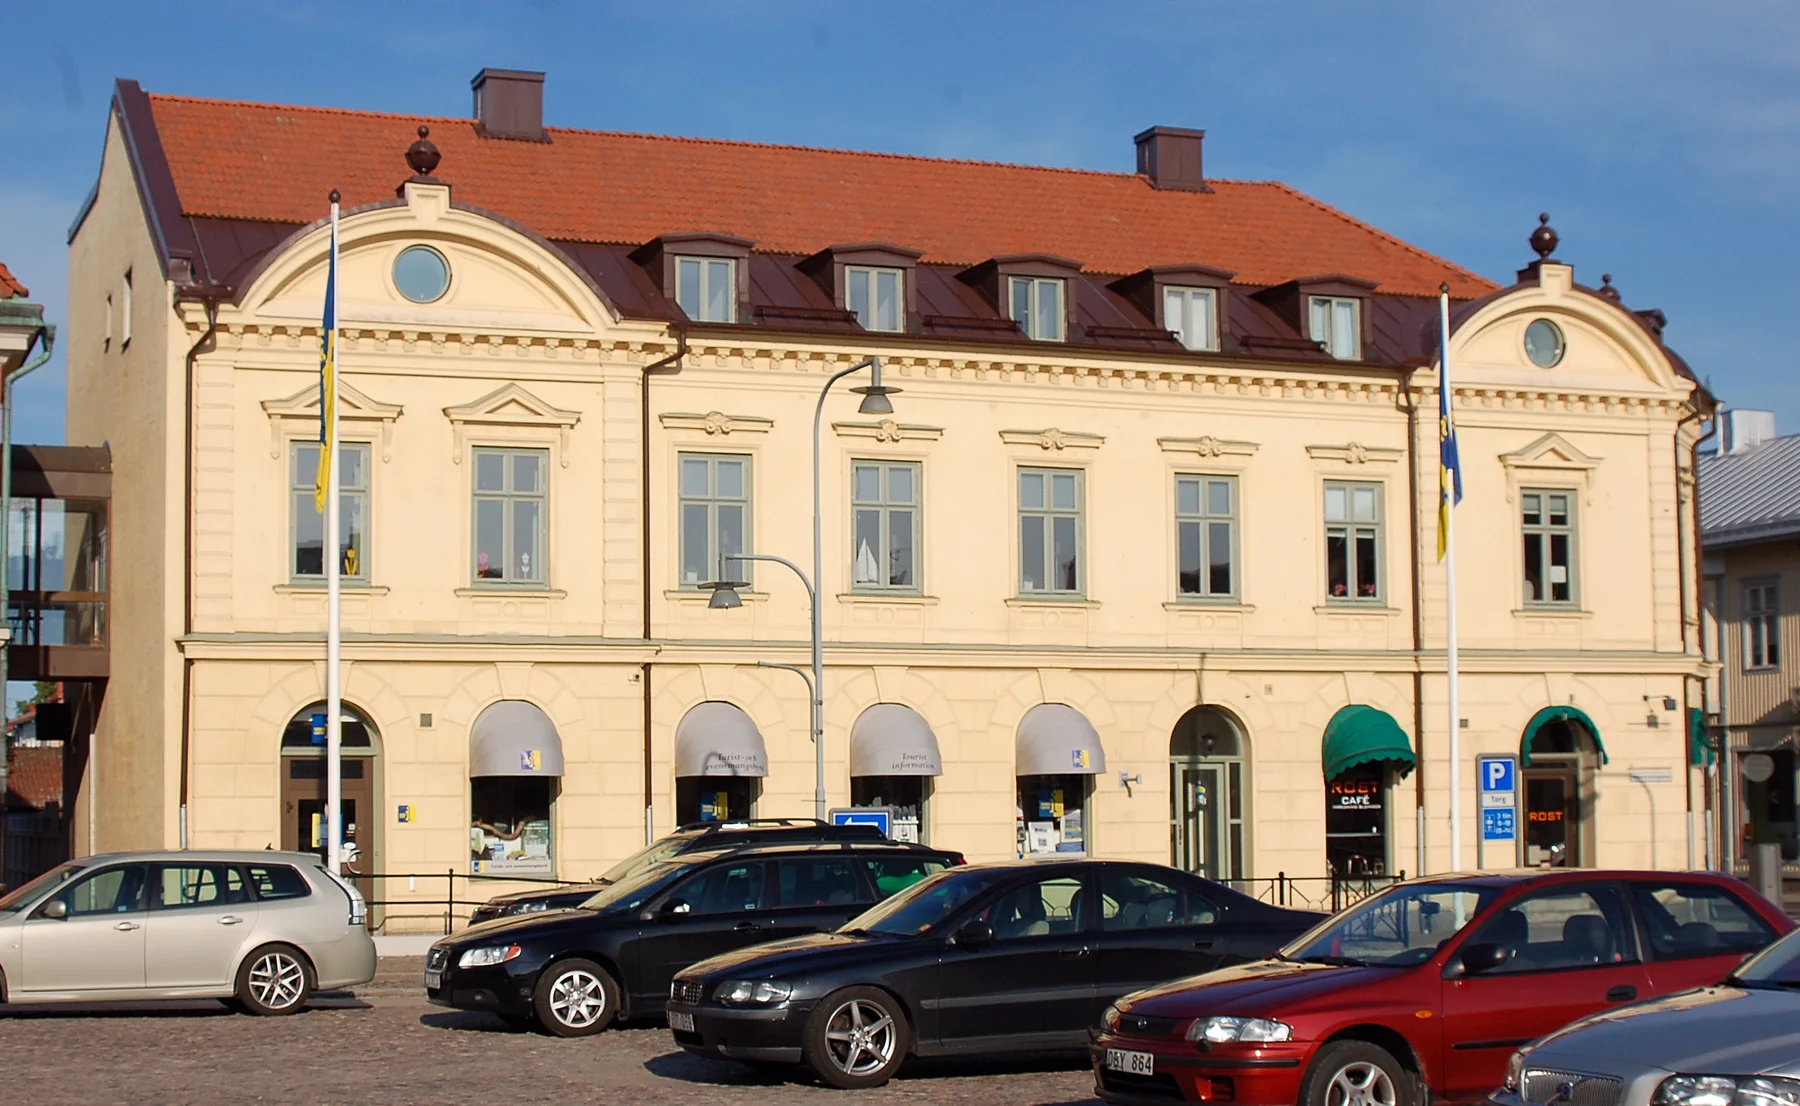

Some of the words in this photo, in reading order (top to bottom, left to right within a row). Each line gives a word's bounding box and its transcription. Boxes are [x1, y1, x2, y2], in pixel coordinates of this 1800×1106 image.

[892, 761, 935, 771] information
[1489, 763, 1506, 789] P
[1332, 781, 1379, 794] ROST
[1341, 794, 1370, 805] CAFÉ
[1491, 796, 1506, 804] Torg
[1529, 812, 1563, 821] ROST
[1132, 1054, 1151, 1073] 864
